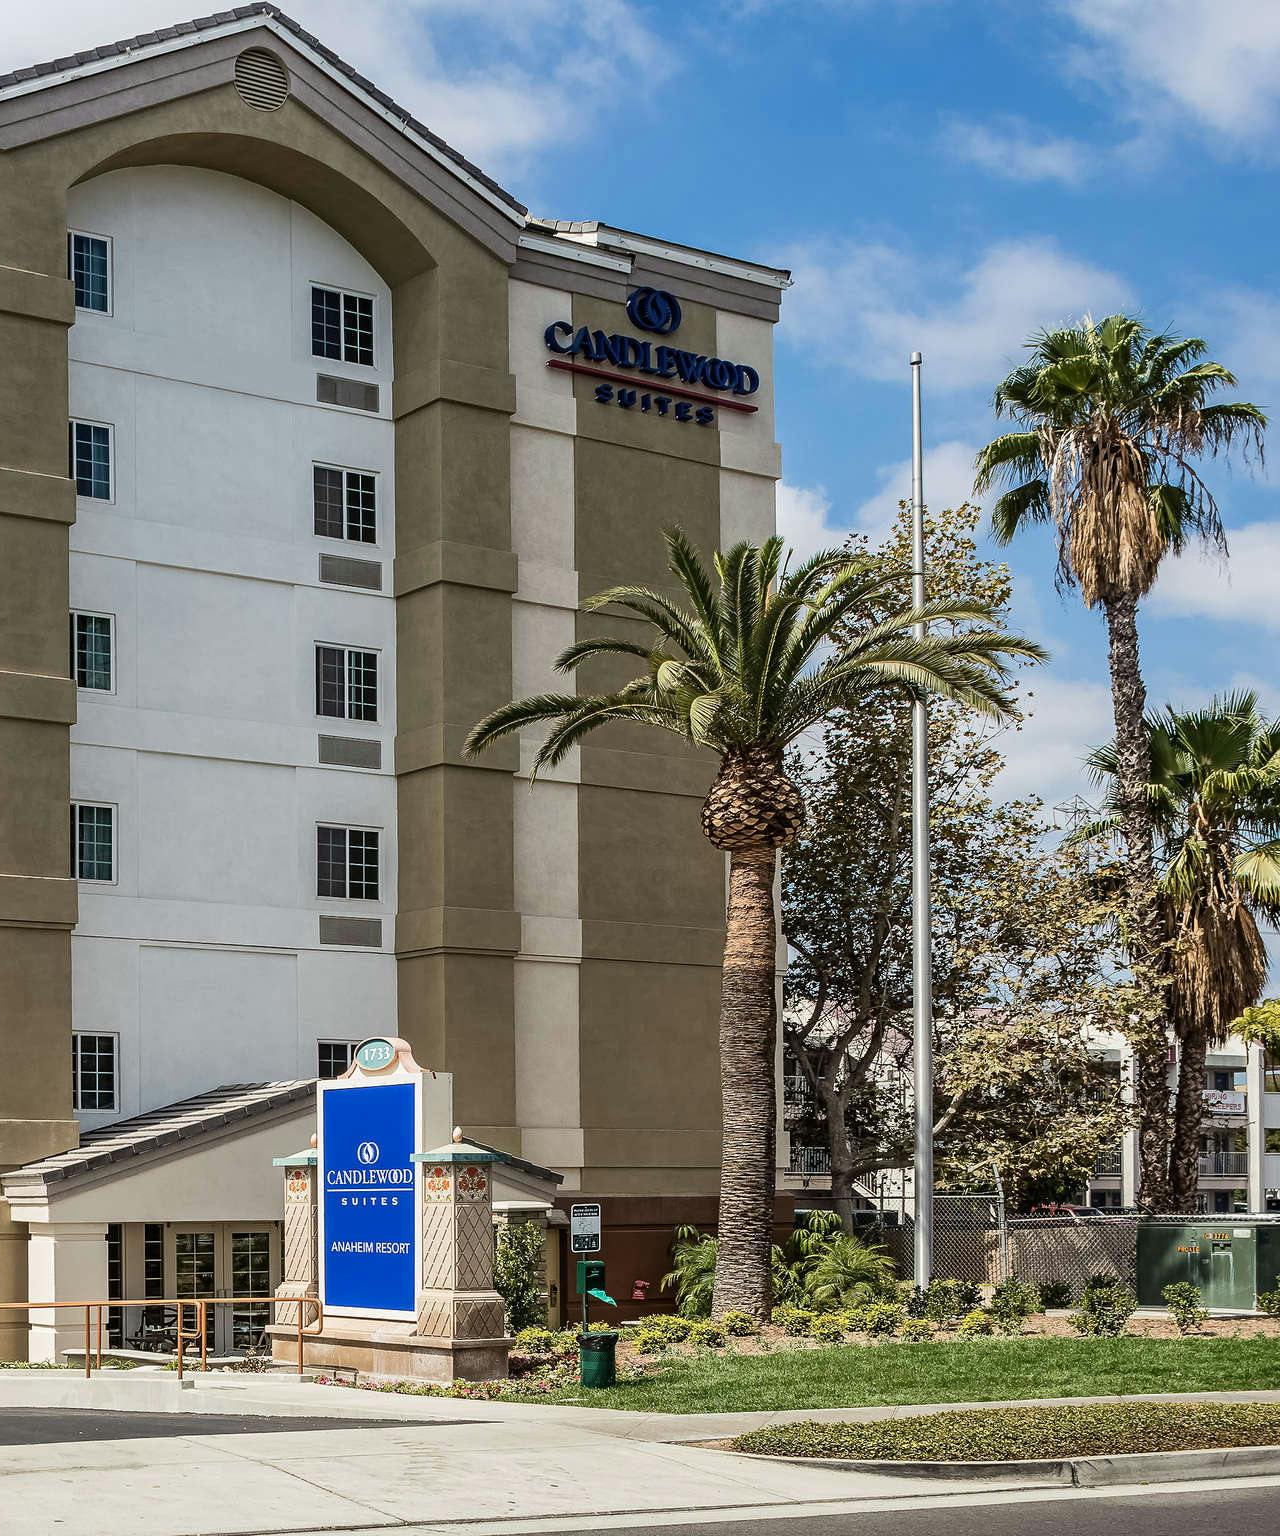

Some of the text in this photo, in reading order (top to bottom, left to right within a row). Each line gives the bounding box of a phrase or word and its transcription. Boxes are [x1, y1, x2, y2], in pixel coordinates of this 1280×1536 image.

[544, 320, 760, 396] CANDLEWOOD
[594, 383, 715, 425] SUITES
[364, 1046, 391, 1061] 1733
[327, 1168, 414, 1185] CANDLEWOOD
[341, 1197, 399, 1206] SUITES
[331, 1241, 411, 1254] ANAHEIM RESORT
